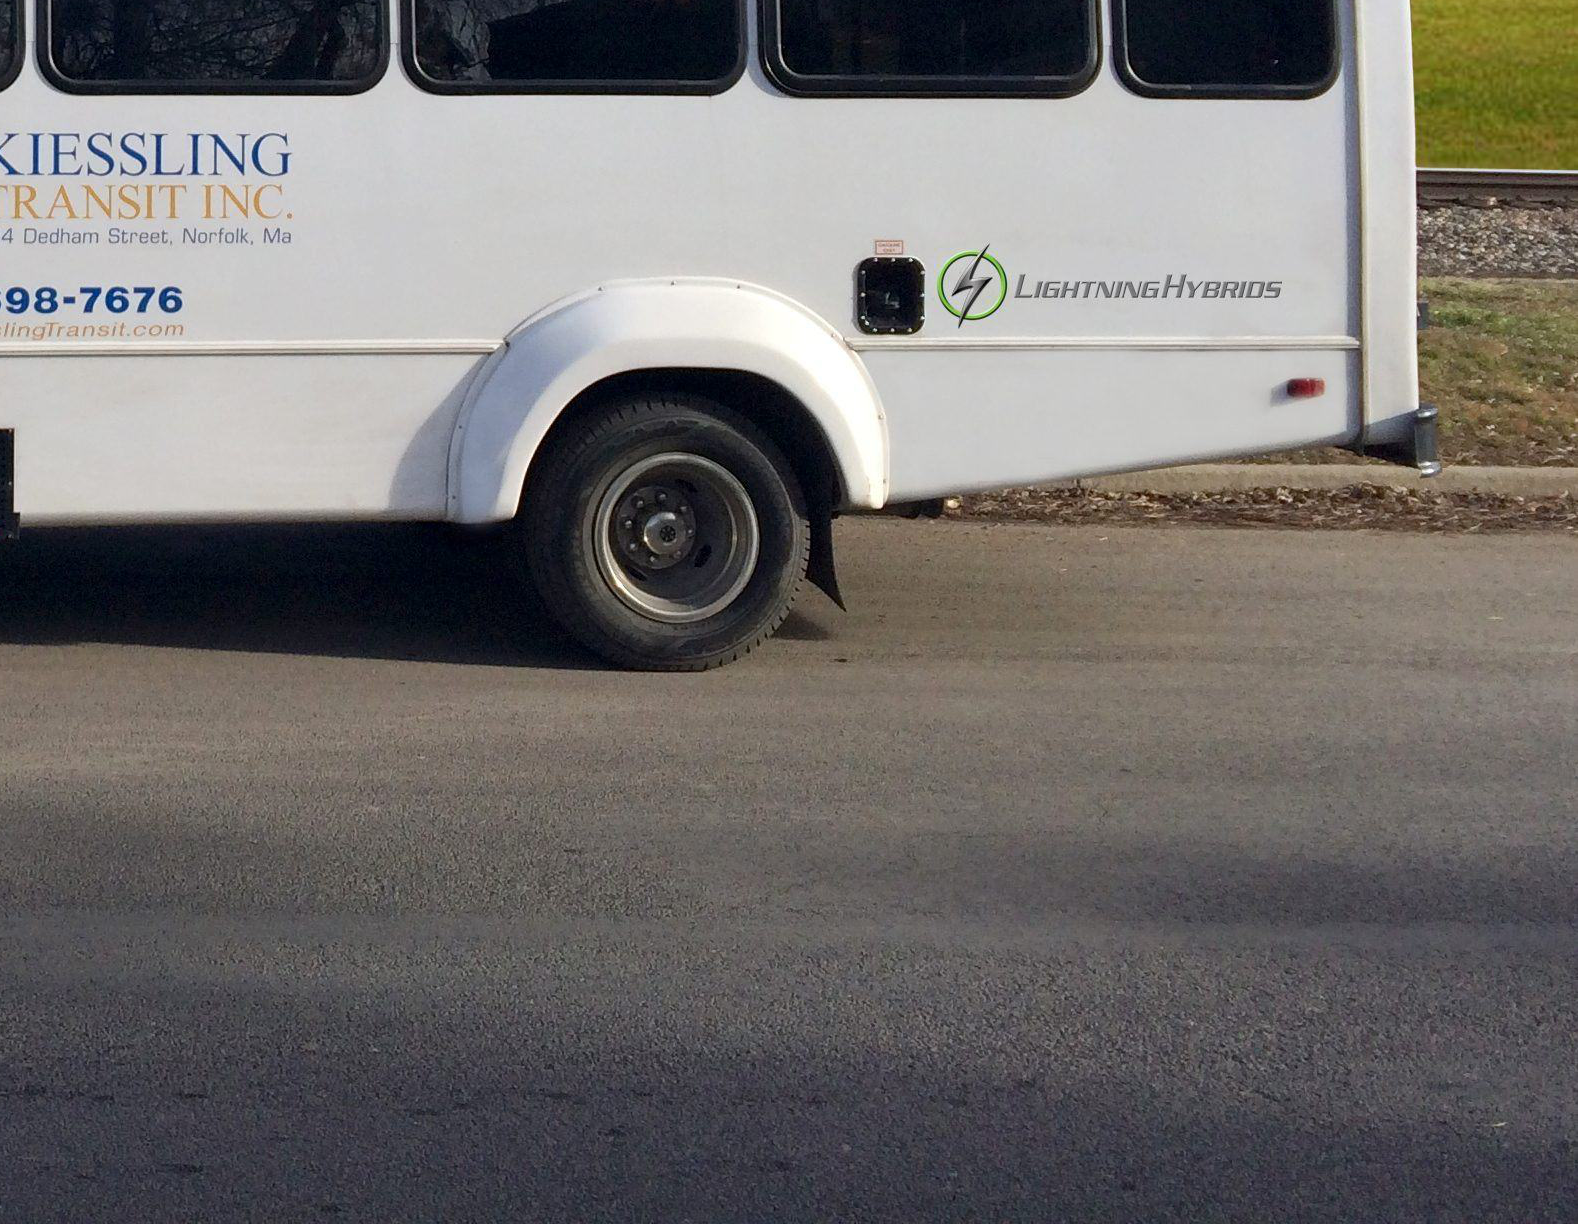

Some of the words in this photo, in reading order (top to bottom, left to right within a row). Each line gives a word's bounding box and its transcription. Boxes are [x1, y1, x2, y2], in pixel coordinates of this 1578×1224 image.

[201, 183, 293, 220] INC.
[23, 227, 99, 245] Dedham
[108, 227, 174, 246] Street,
[182, 227, 255, 246] Norfolk,
[263, 227, 292, 245] Ma
